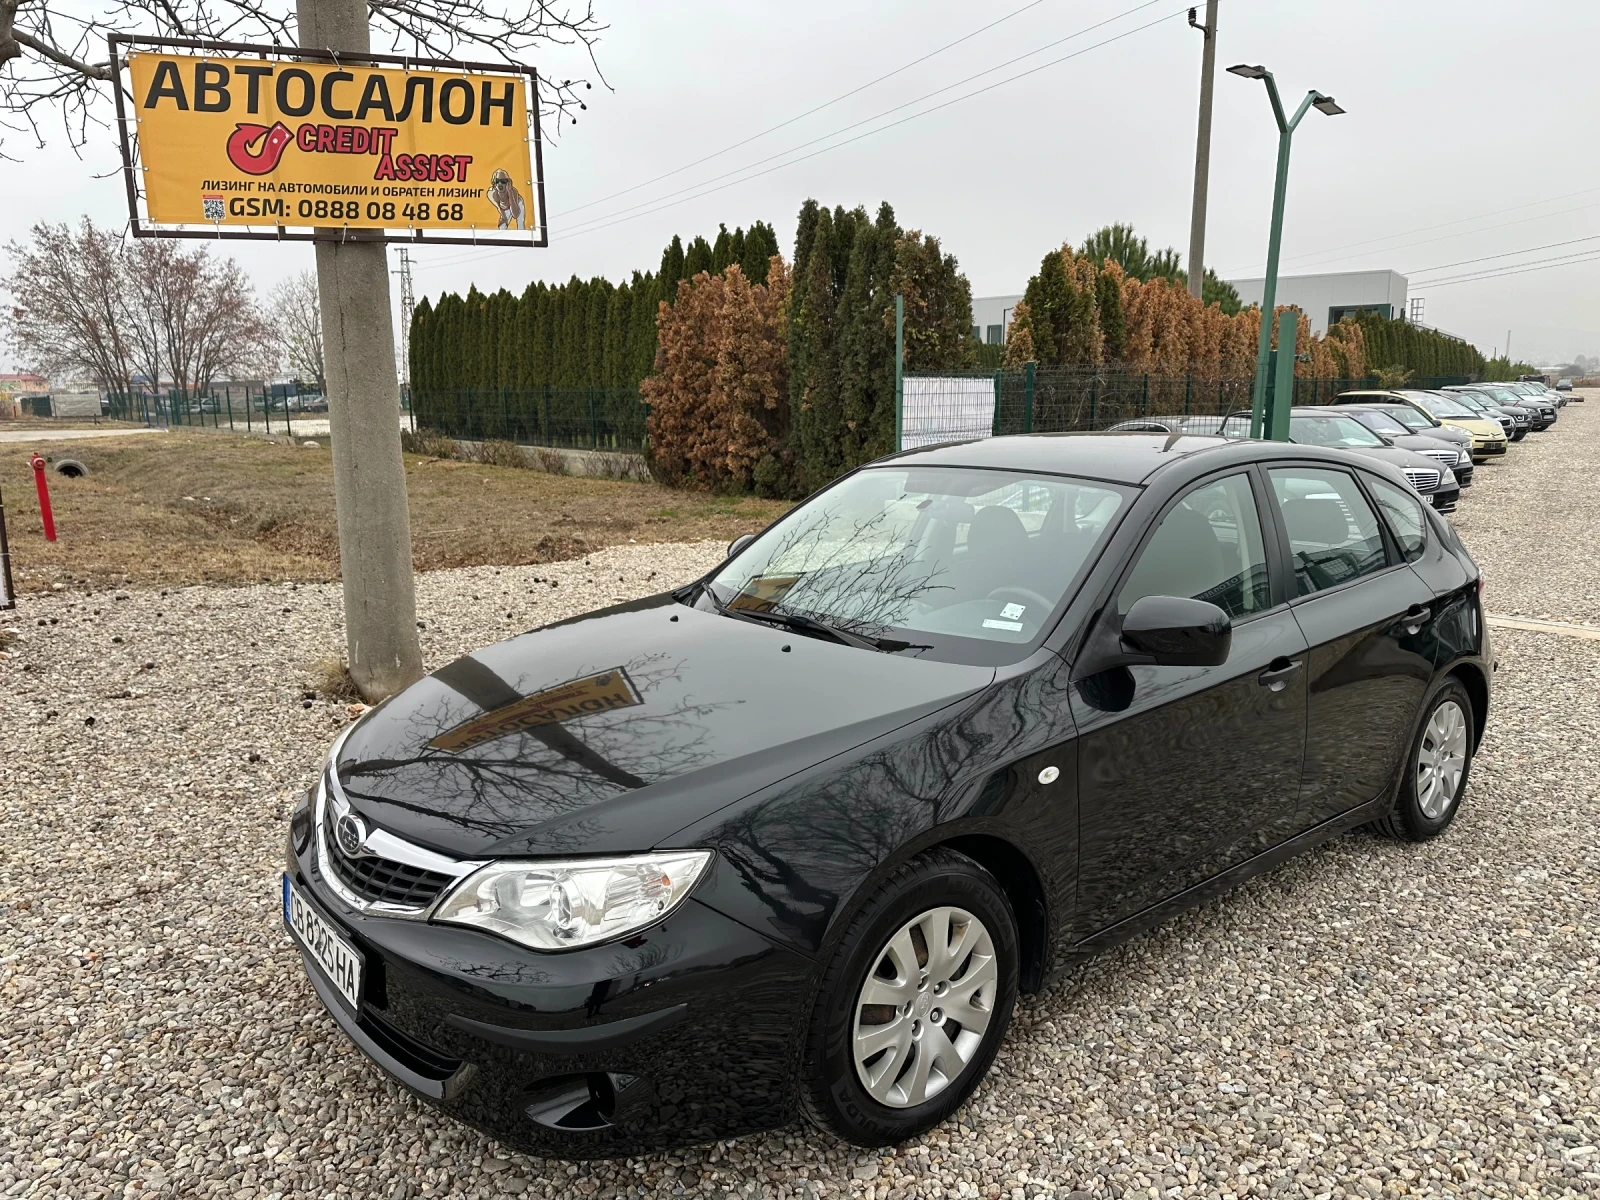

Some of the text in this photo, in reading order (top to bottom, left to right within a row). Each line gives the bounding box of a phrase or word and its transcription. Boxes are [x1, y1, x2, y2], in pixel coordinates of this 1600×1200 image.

[143, 60, 515, 127] АВТОСАЛОН
[297, 123, 398, 155] CREDIT
[374, 153, 473, 182] ASSIST
[201, 180, 484, 198] ЛИЗИНГ НА АВТОМОБИЛИ И ОБРАТЕН ЛИЗИНГ
[229, 197, 464, 221] GSM: 0888 08 48 68
